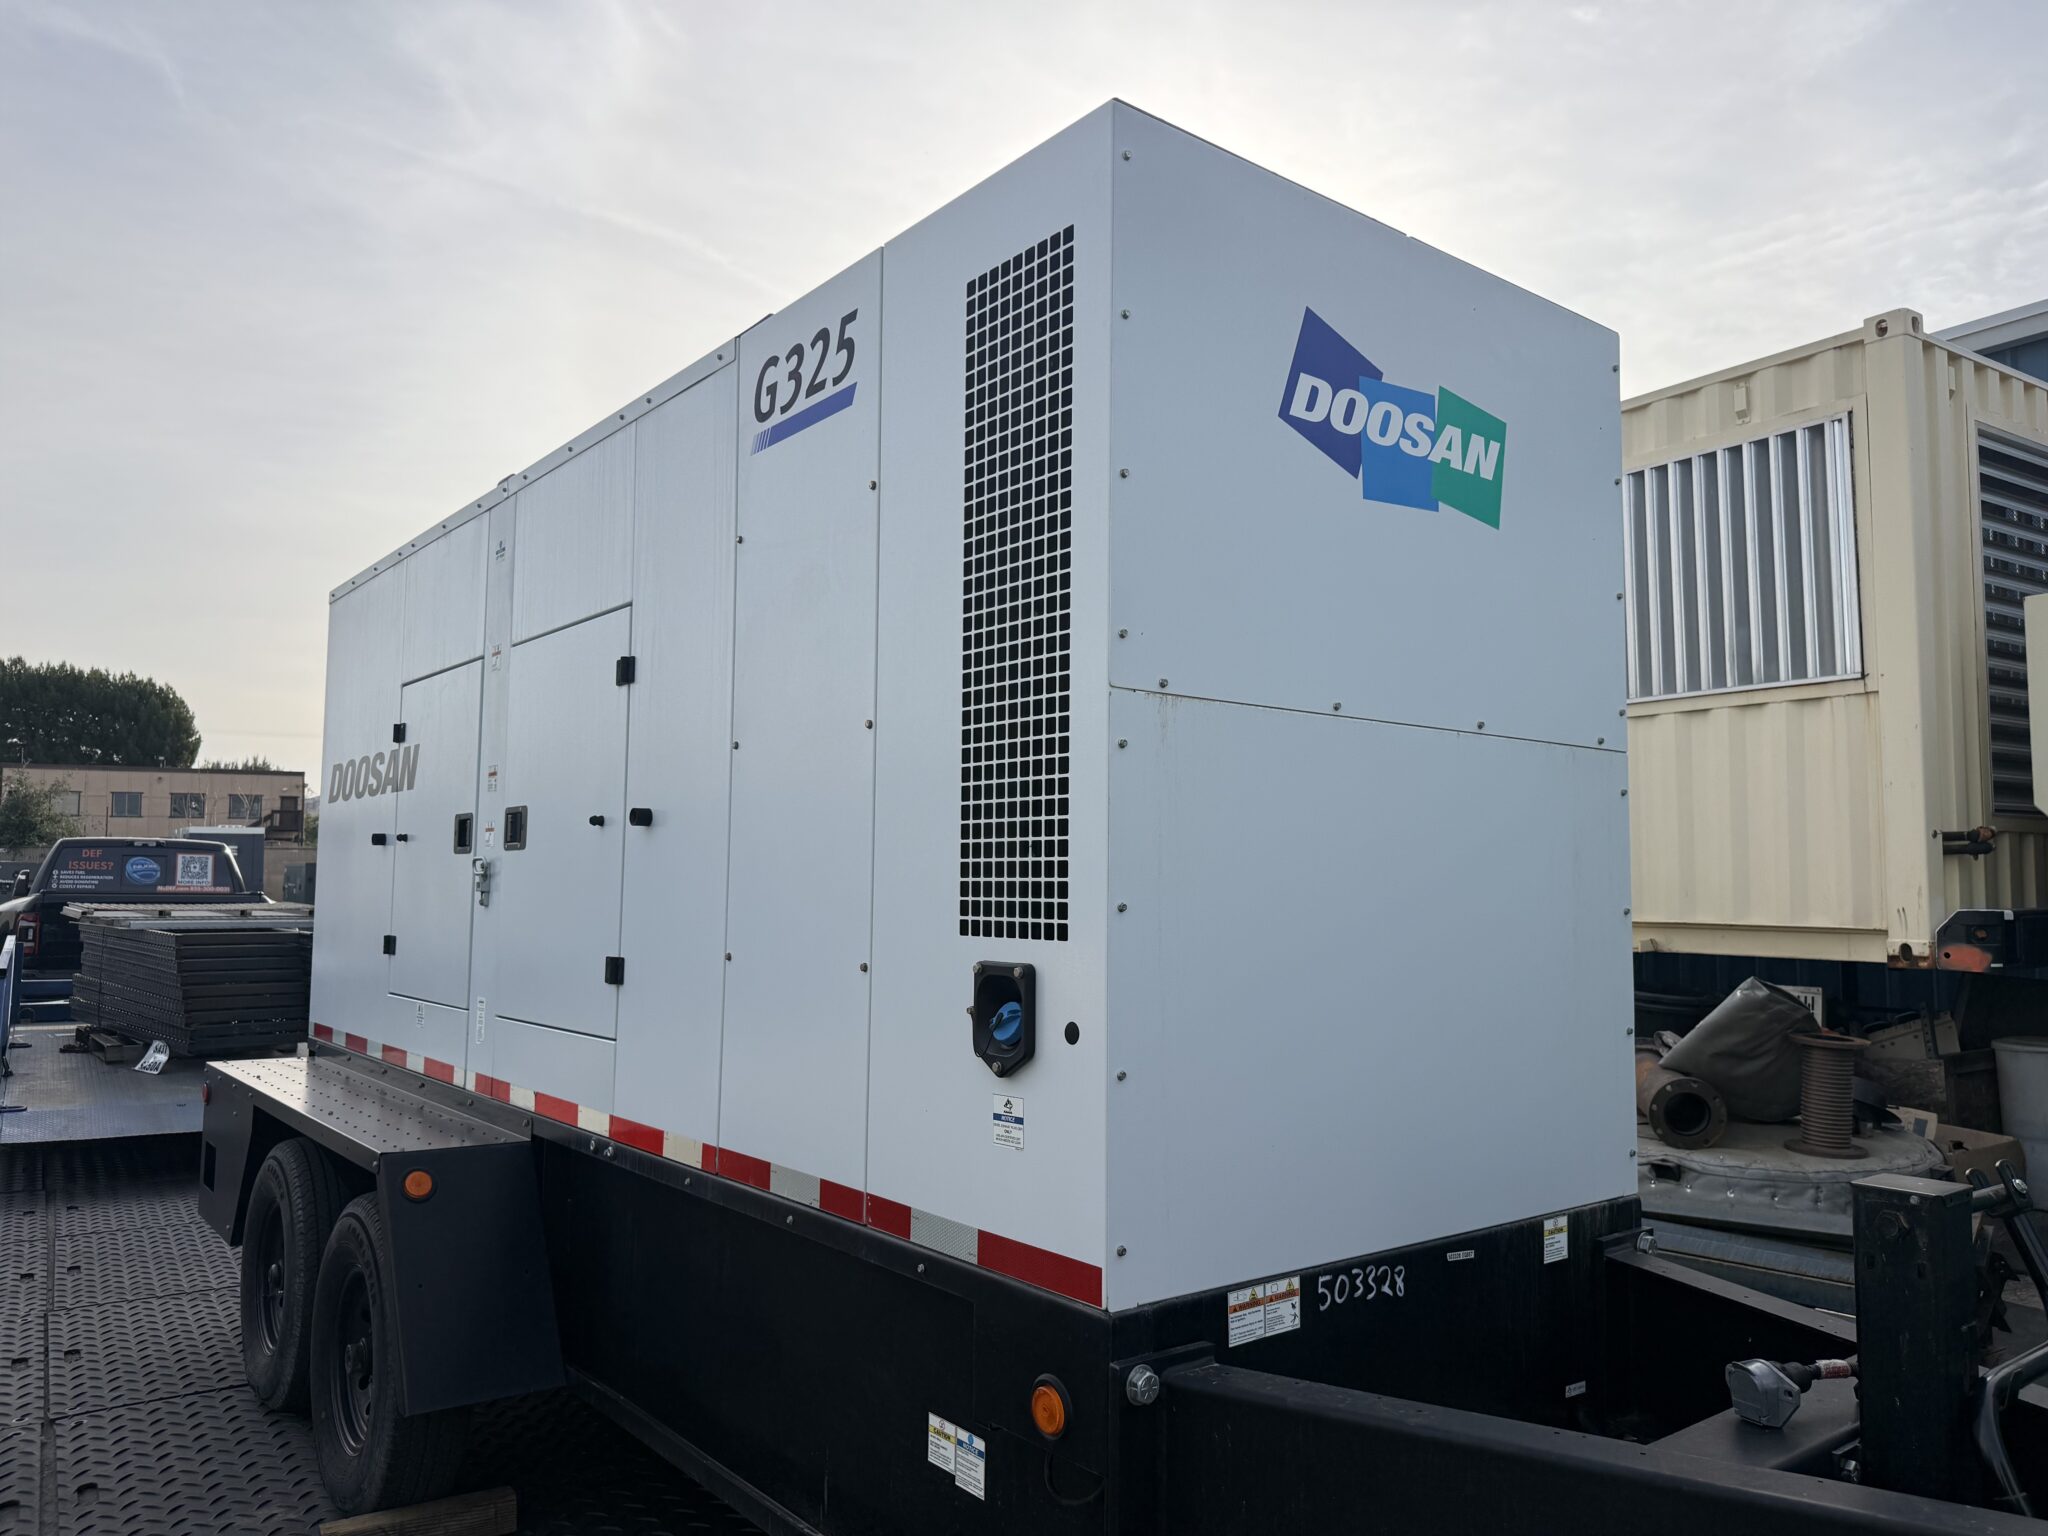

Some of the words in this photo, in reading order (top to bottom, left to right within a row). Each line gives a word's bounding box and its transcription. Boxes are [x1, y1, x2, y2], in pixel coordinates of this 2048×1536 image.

[753, 307, 859, 424] G325
[1288, 371, 1501, 481] DOOSAN
[327, 743, 421, 804] DOOSAN
[68, 860, 114, 870] ISSUES?
[82, 849, 103, 857] DEF
[1317, 1264, 1406, 1312] 503328
[1238, 1299, 1263, 1309] WARNING
[933, 1427, 951, 1441] CAUTION
